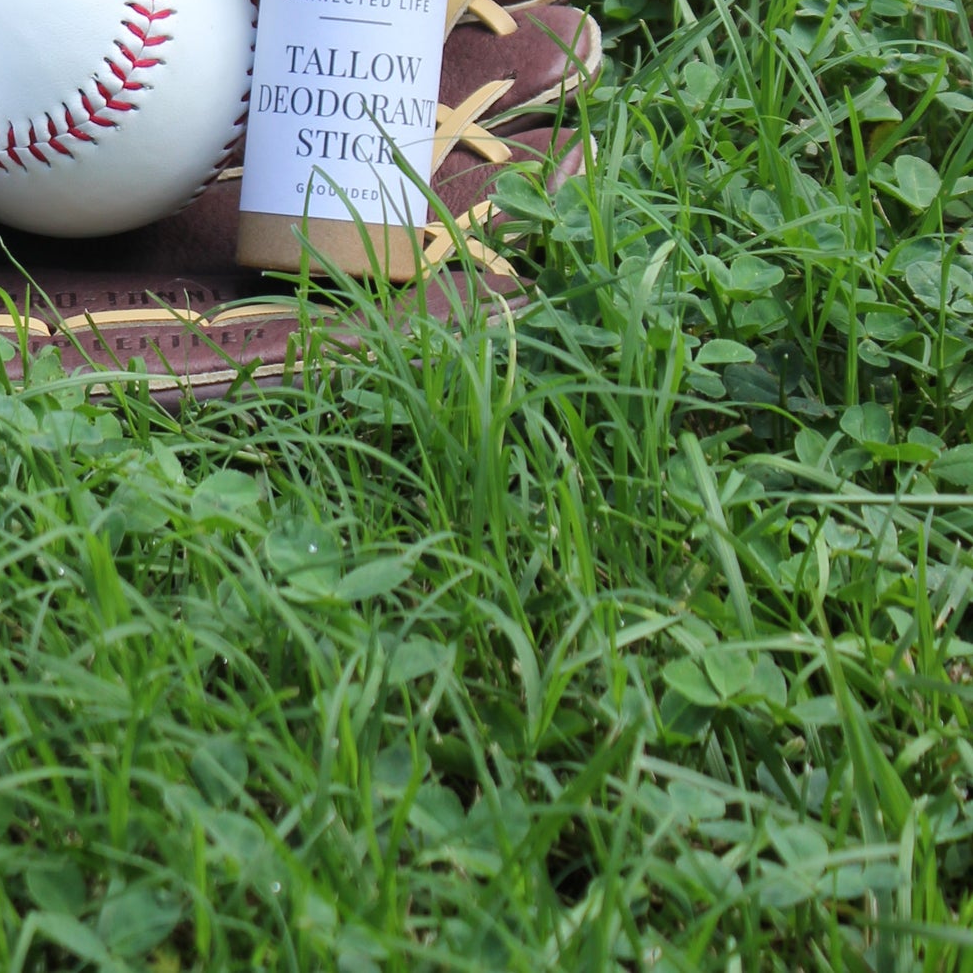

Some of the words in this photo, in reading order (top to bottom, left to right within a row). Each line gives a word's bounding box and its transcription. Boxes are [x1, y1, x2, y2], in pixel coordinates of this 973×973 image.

[285, 45, 423, 84] TALLOW
[258, 84, 435, 128] DEODORANT
[296, 127, 397, 165] STICK
